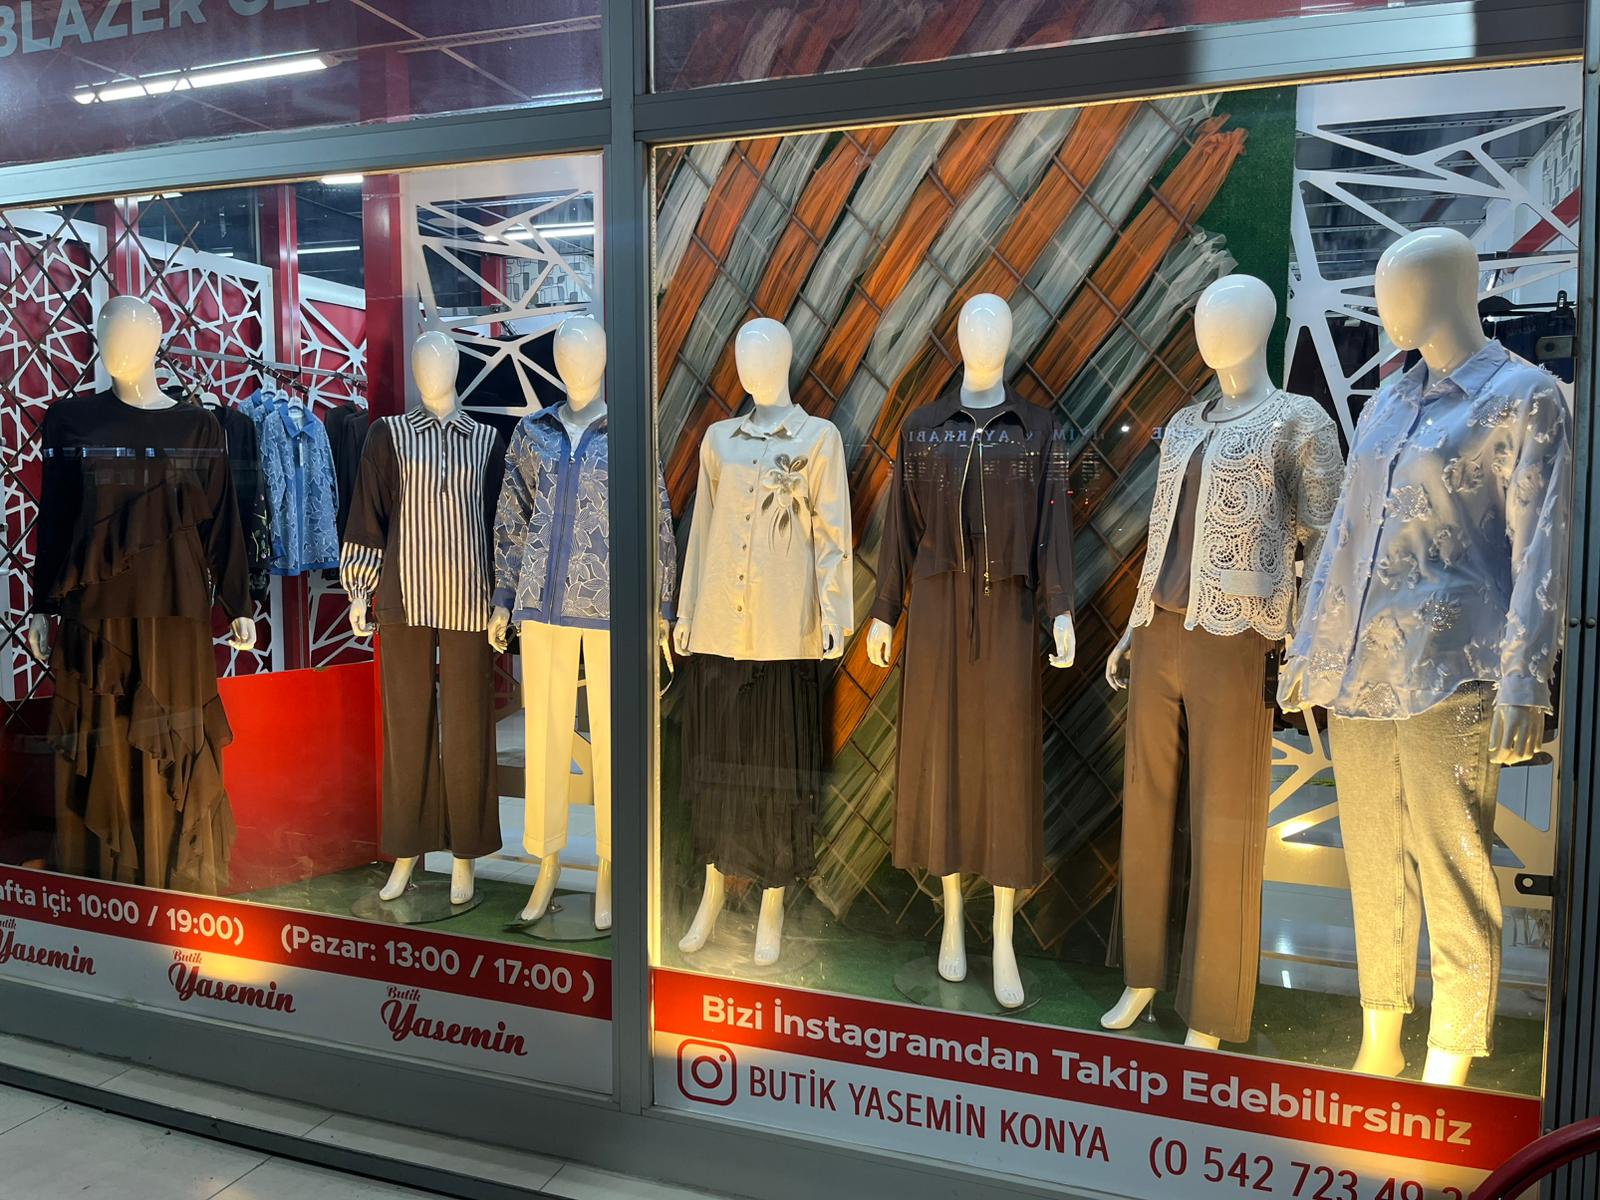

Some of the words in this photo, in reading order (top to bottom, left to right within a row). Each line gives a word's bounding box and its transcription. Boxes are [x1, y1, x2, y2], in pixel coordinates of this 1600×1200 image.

[42, 886, 72, 918] içi:
[77, 893, 140, 925] 10:00
[147, 906, 159, 926] /
[166, 907, 244, 946] 19:00)
[281, 923, 377, 961] (Pazar:
[384, 940, 460, 976] 13:00
[469, 955, 485, 978] /
[494, 958, 573, 994] 17:00
[173, 950, 203, 964] Butik
[168, 962, 296, 1013] Yasemin
[385, 985, 421, 1002] Butik
[380, 999, 528, 1056] Yasemin
[702, 994, 763, 1030] Bizi
[773, 999, 1039, 1076] İnstagramdan
[1052, 1049, 1169, 1104] Takip
[1182, 1070, 1473, 1146] Edebilirsiniz
[749, 1066, 837, 1112] BUTİK
[848, 1083, 986, 1139] YASEMİN
[1000, 1109, 1110, 1162] KONYA
[1149, 1136, 1188, 1178] (0
[1203, 1147, 1274, 1192] 542
[1290, 1161, 1359, 1200] 723
